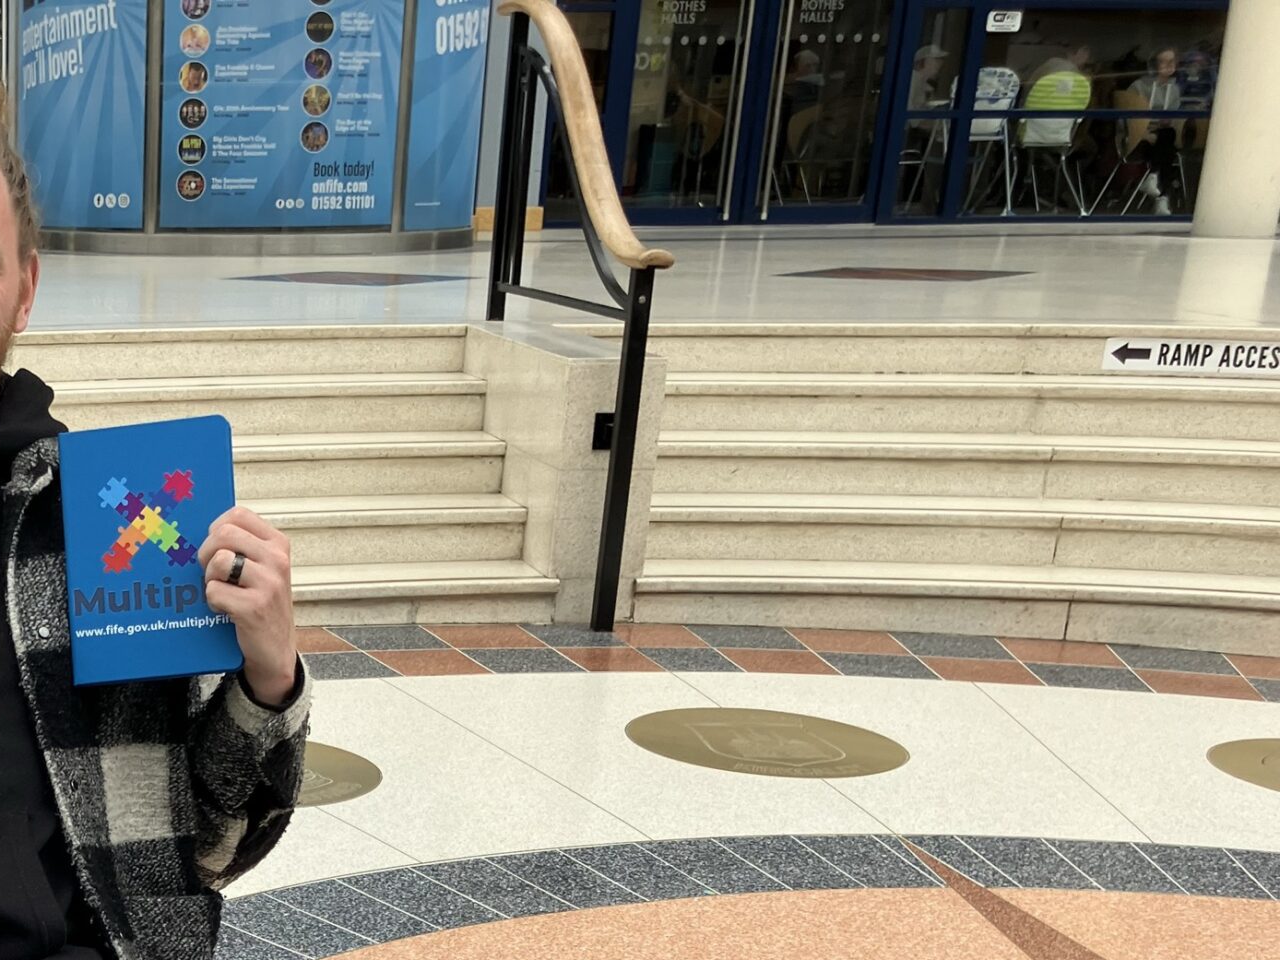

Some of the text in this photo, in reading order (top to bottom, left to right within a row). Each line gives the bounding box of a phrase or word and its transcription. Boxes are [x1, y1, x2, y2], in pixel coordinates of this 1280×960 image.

[23, 0, 117, 55] entertainment
[661, 13, 696, 24] HALLS
[800, 12, 834, 23] HALLS
[436, 9, 479, 55] 01592
[48, 38, 83, 81] love!
[313, 160, 374, 180] Book today!
[312, 180, 368, 194] onfife.com
[312, 196, 342, 210] 01592
[1157, 343, 1213, 366] RAMP
[73, 575, 207, 617] Multipl
